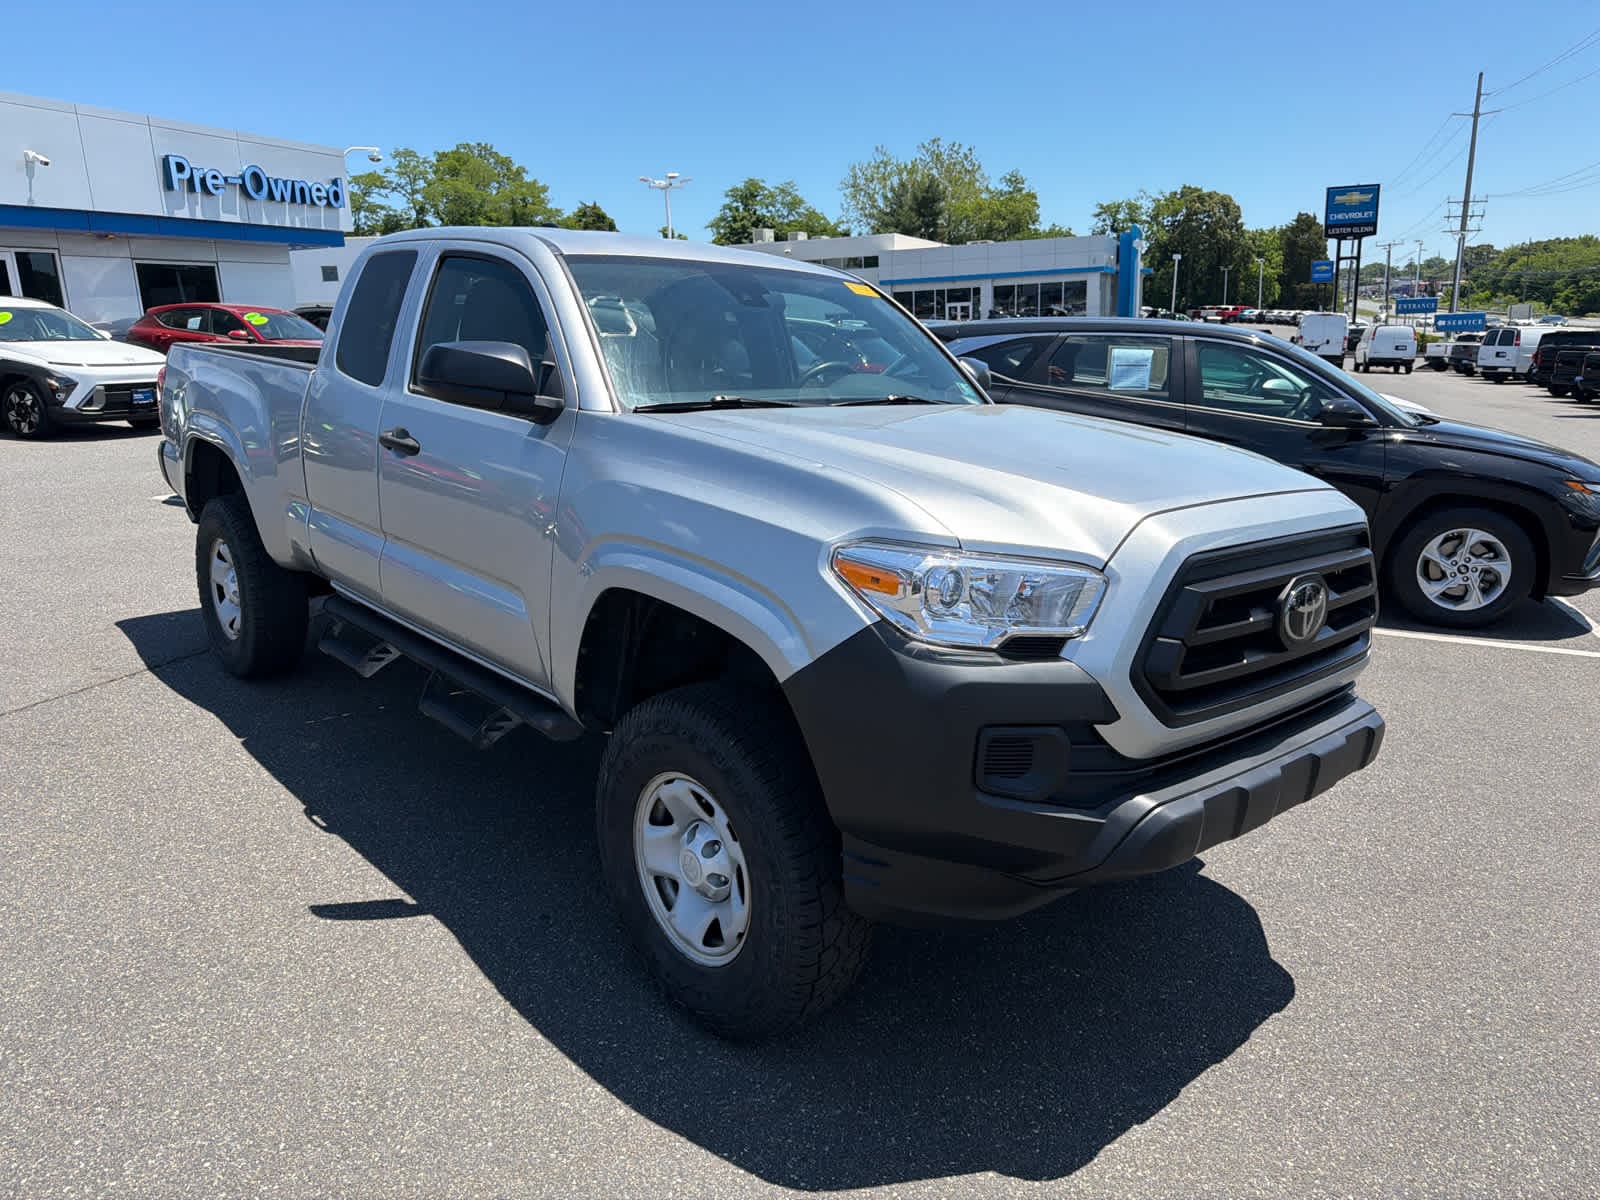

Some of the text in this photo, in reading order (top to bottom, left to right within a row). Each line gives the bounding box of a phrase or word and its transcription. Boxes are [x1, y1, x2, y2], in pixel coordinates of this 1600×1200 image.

[163, 154, 345, 208] Pre-Owned
[1329, 211, 1373, 220] CHEVROLET
[1398, 302, 1436, 310] ENTRANCE
